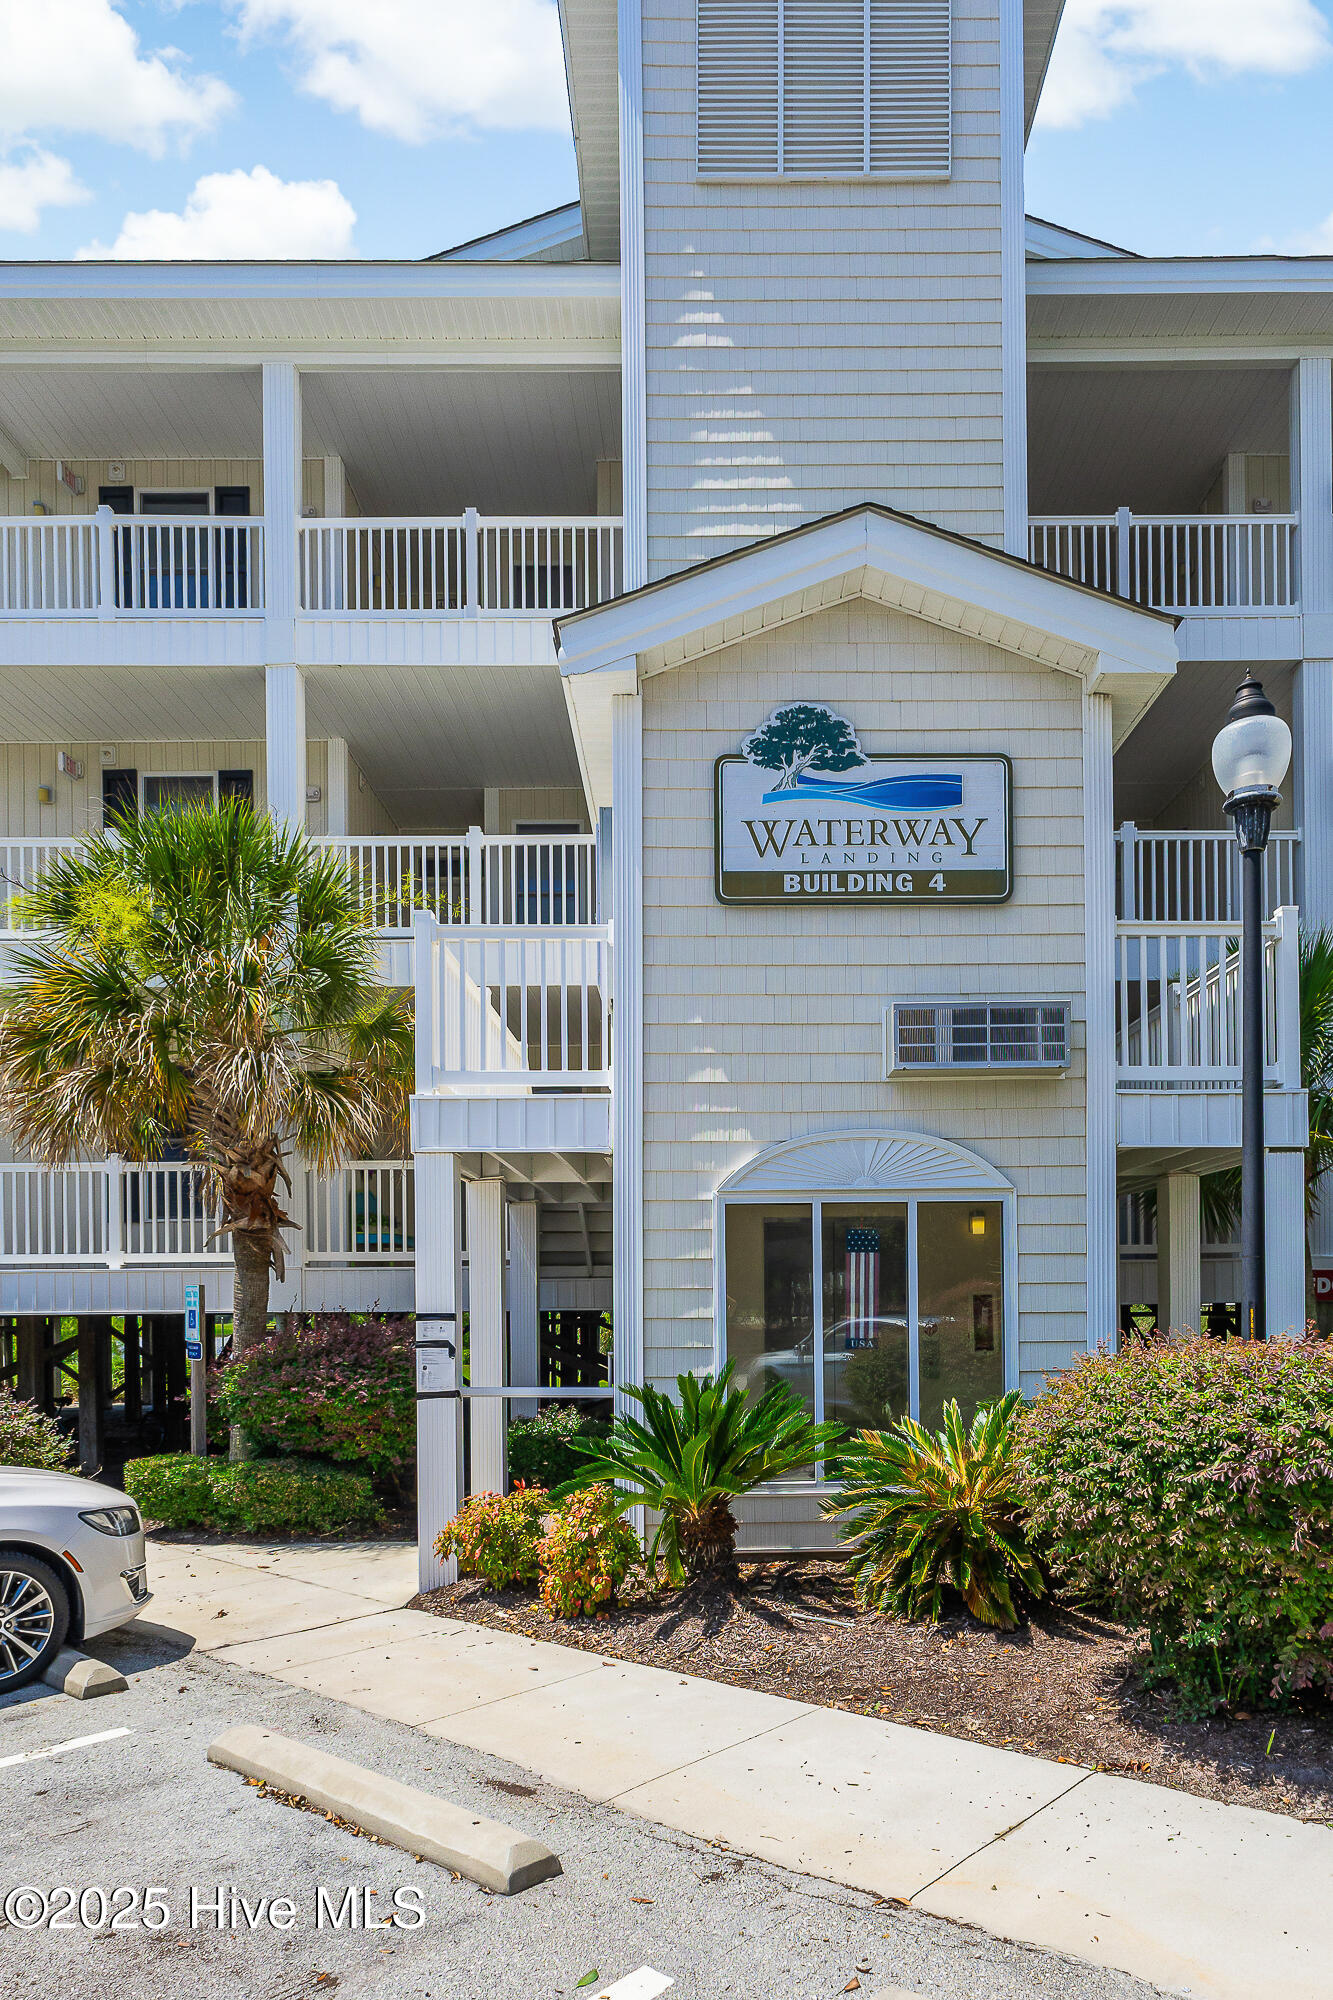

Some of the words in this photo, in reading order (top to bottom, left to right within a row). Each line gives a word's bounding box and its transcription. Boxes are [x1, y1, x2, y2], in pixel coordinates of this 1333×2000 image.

[741, 818, 989, 858] WATERWAY
[801, 852, 943, 864] LANDING
[783, 873, 914, 893] BUILDING
[928, 873, 947, 892] 4
[851, 1339, 874, 1348] USA
